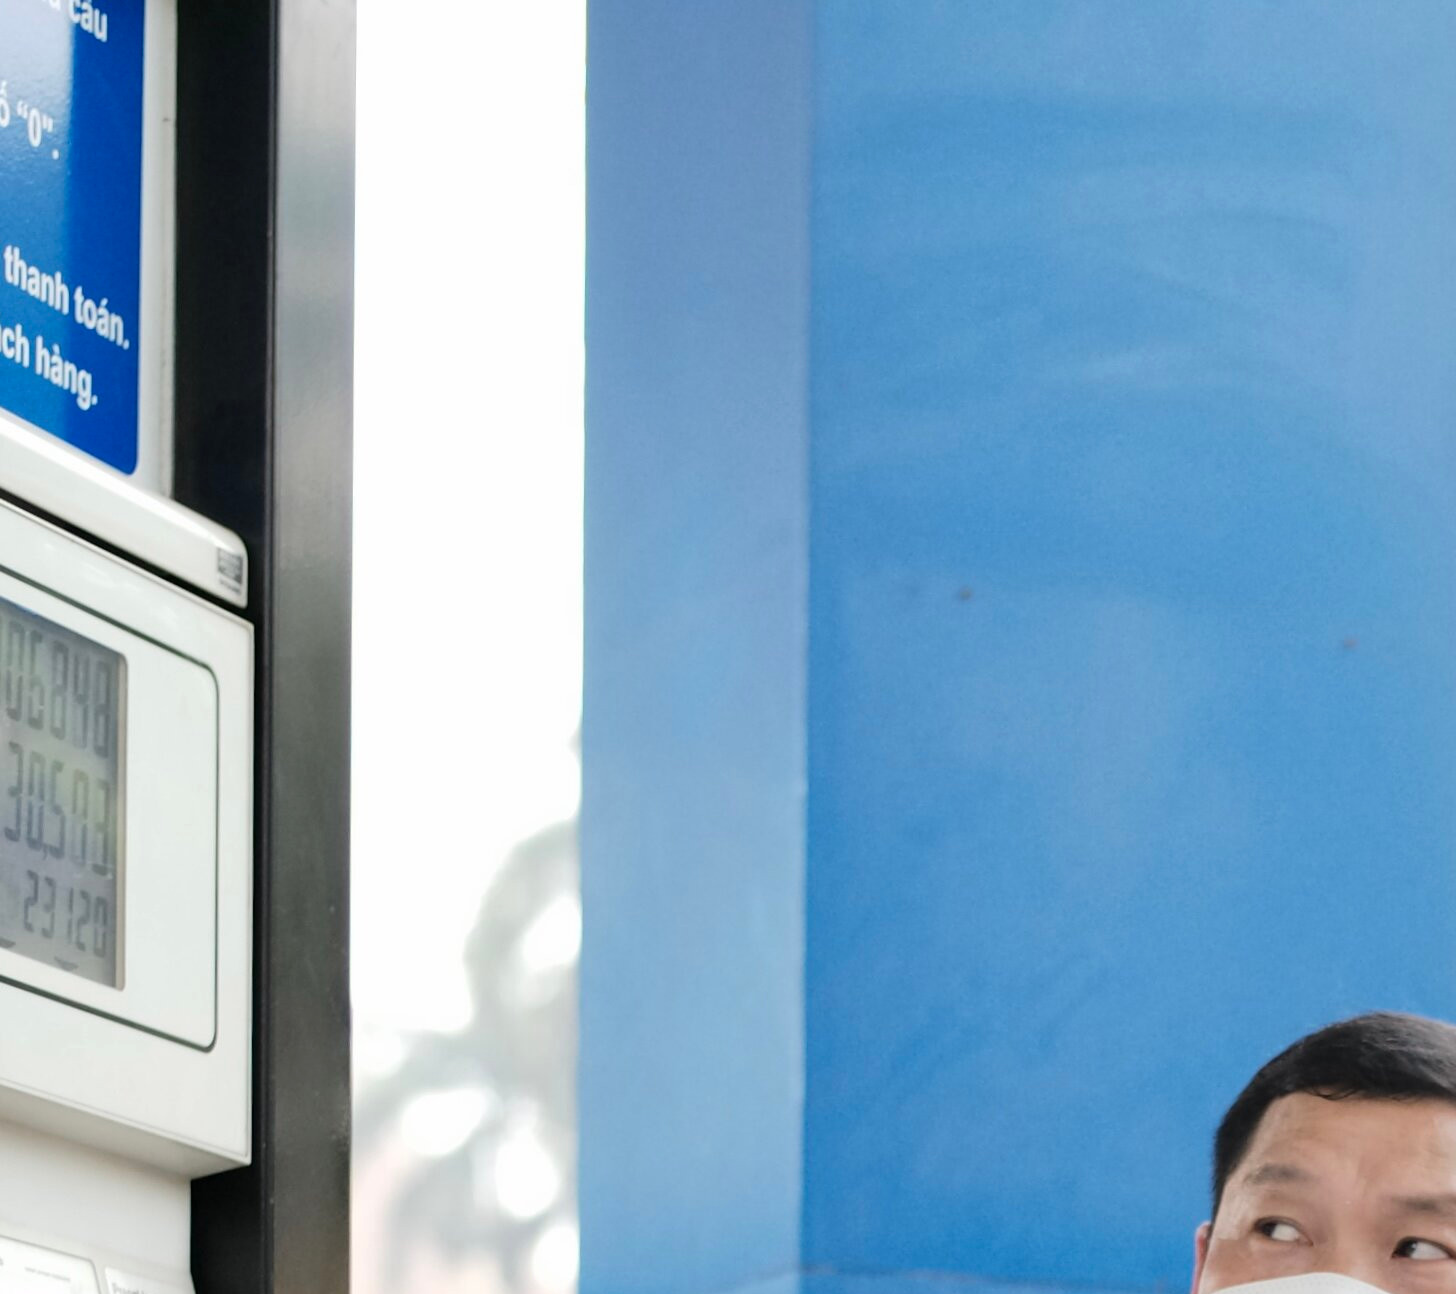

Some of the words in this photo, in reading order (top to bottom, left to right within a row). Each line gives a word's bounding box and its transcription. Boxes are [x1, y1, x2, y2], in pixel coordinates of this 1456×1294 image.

[4, 245, 69, 315] thanh
[74, 285, 130, 350] toán.
[35, 335, 98, 411] hàng.
